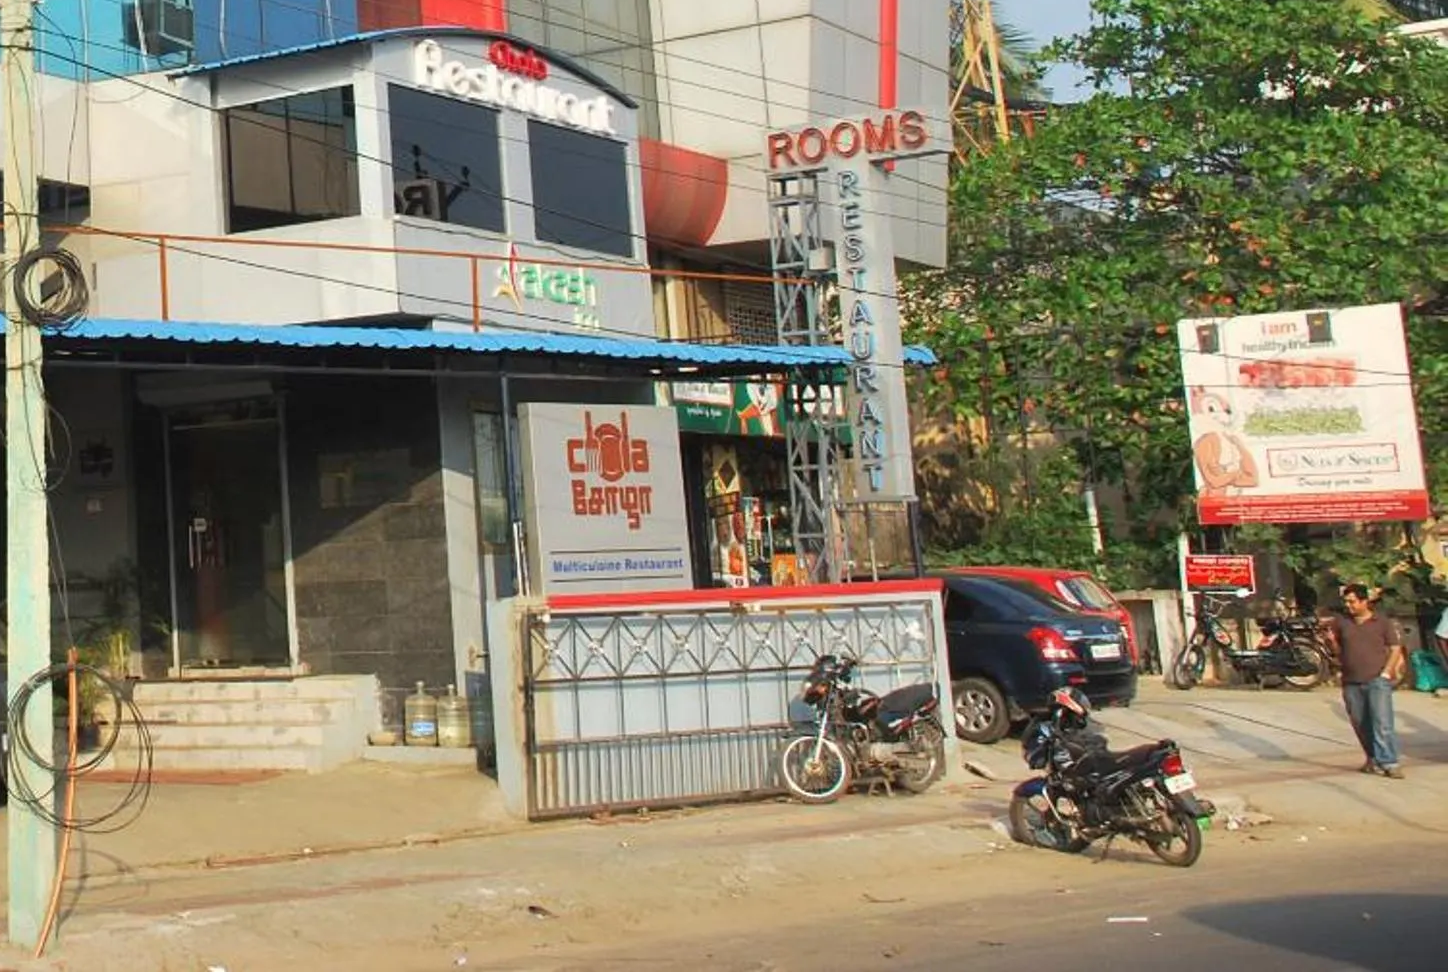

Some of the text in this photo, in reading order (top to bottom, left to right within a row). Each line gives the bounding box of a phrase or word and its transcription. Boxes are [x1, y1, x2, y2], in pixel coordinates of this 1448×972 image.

[413, 38, 618, 137] Restaurant
[767, 110, 927, 169] ROOMS
[837, 170, 883, 492] RESTAURANT
[624, 558, 684, 571] Restaurant
